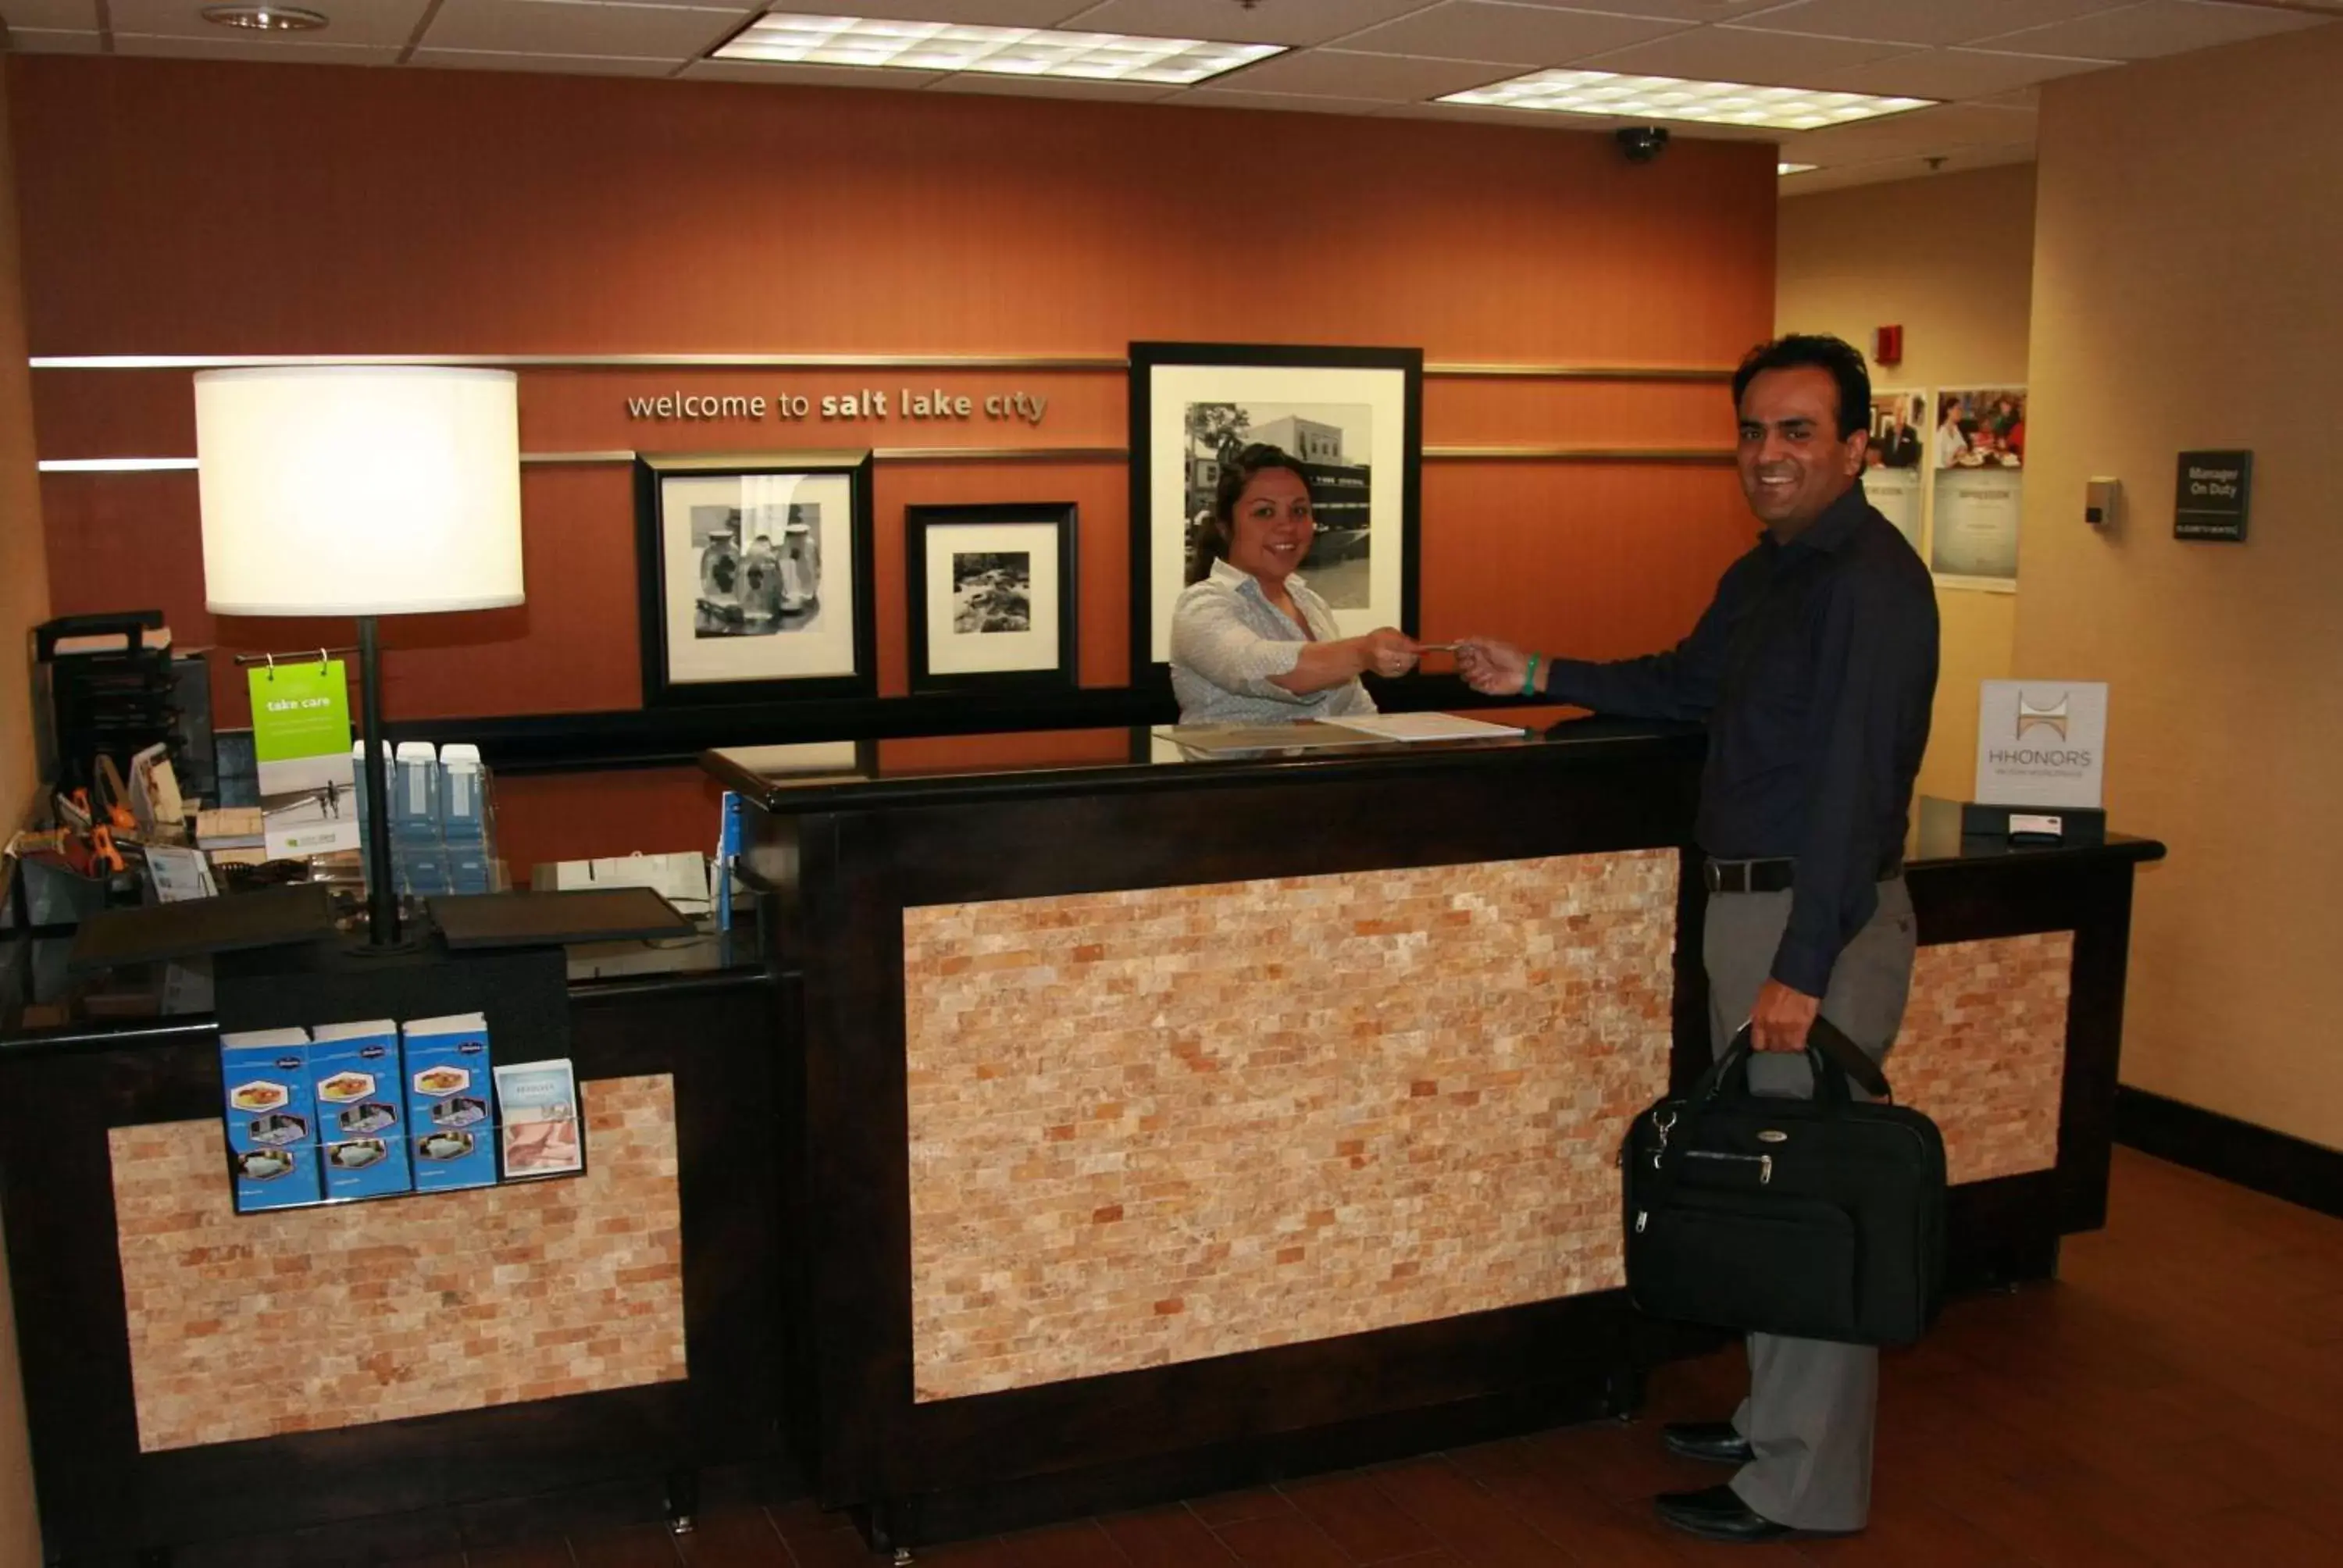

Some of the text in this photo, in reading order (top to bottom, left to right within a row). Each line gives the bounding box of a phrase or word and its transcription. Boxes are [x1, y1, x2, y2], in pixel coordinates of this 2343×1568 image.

[628, 388, 1047, 422] welcome to salt lake city
[2188, 466, 2239, 483] Manager
[2190, 482, 2238, 499] On Duty
[266, 697, 330, 711] take care
[1988, 749, 2092, 767] HHONORS
